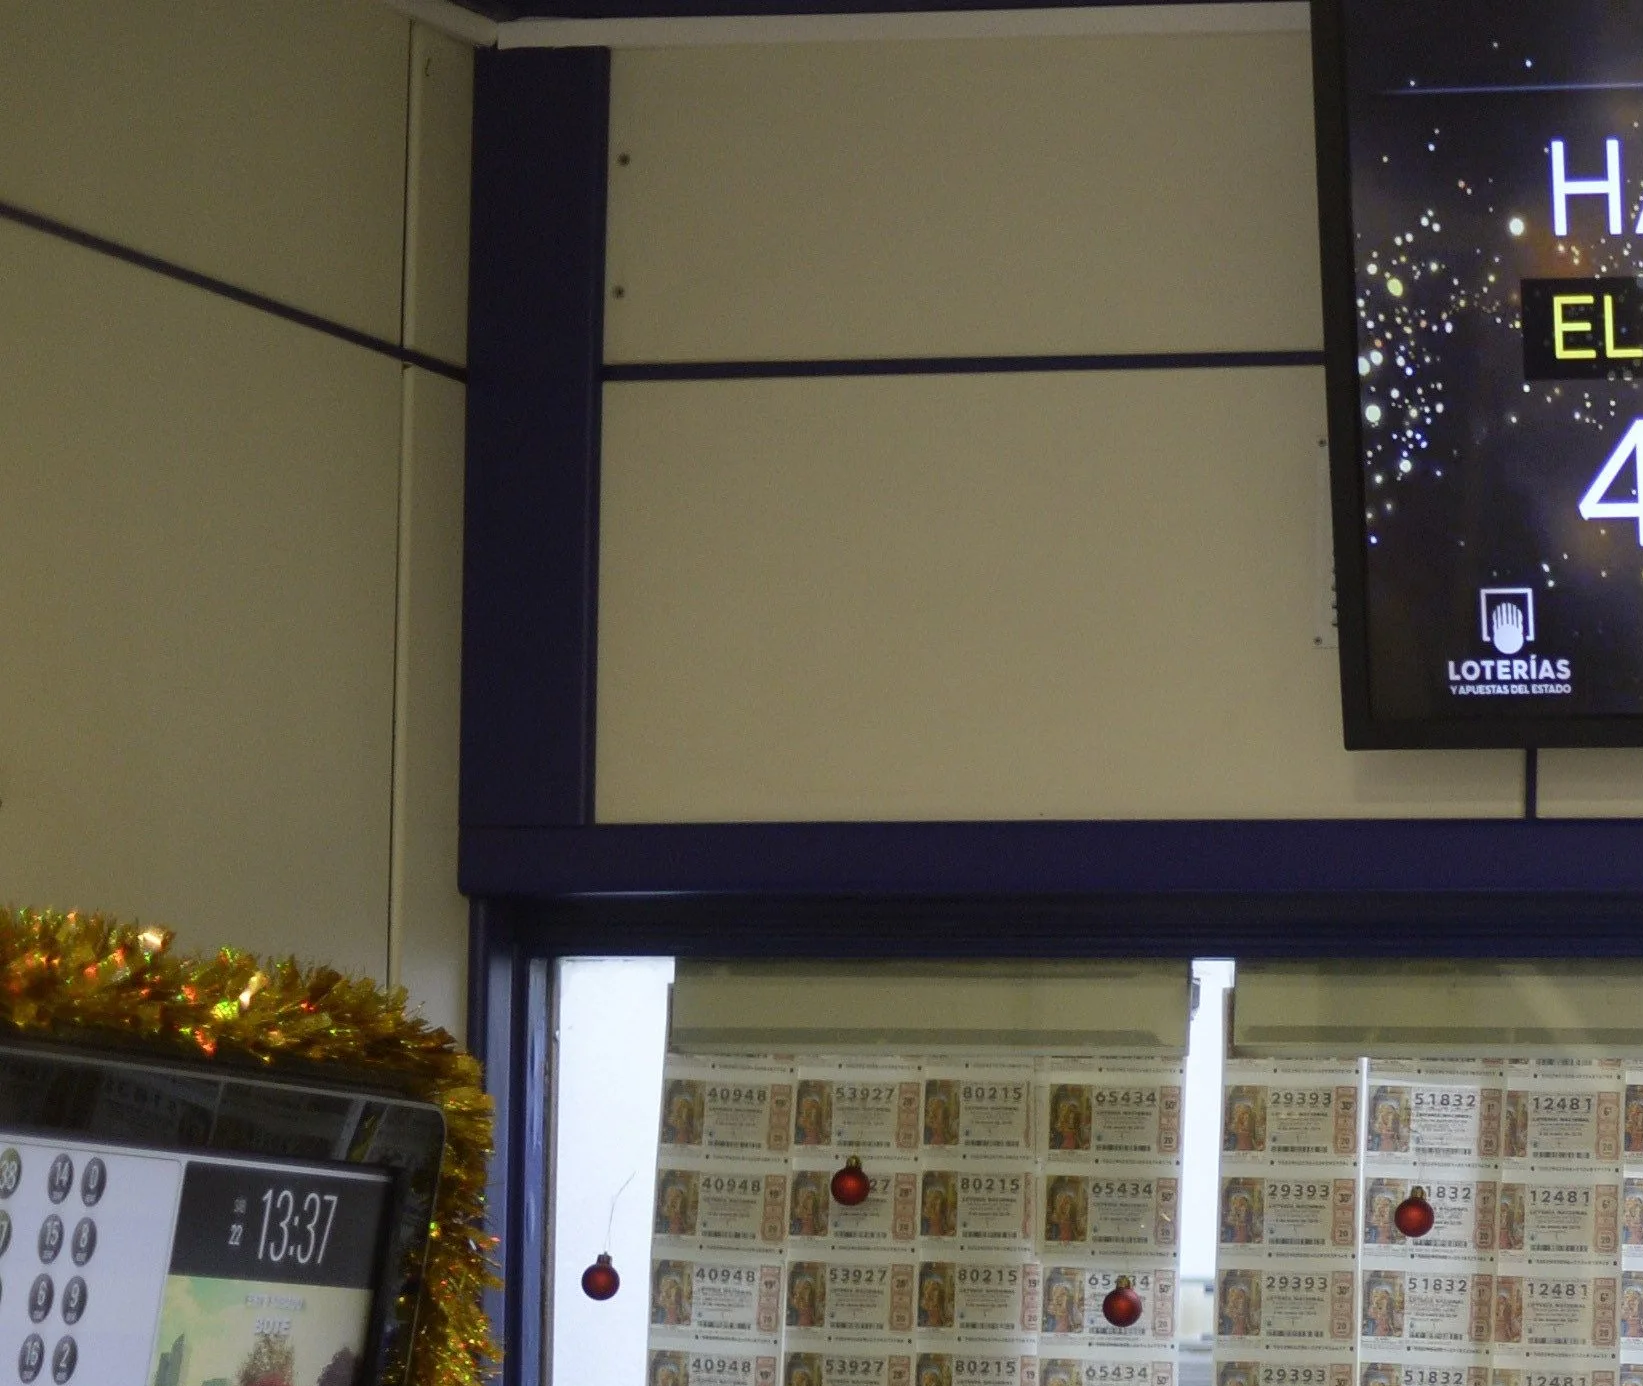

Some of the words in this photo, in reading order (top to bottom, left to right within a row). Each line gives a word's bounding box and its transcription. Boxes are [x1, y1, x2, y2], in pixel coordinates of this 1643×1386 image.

[1552, 294, 1643, 360] EL
[1448, 654, 1571, 680] LOTERÍAS
[707, 1087, 767, 1102] 40948
[835, 1087, 895, 1102] 53927
[963, 1086, 1023, 1102] 80215
[1095, 1091, 1157, 1107] 65434
[1271, 1091, 1332, 1107] 29393
[1414, 1093, 1477, 1108] 51832
[1533, 1098, 1593, 1113] 12481
[257, 1188, 338, 1265] 13:37
